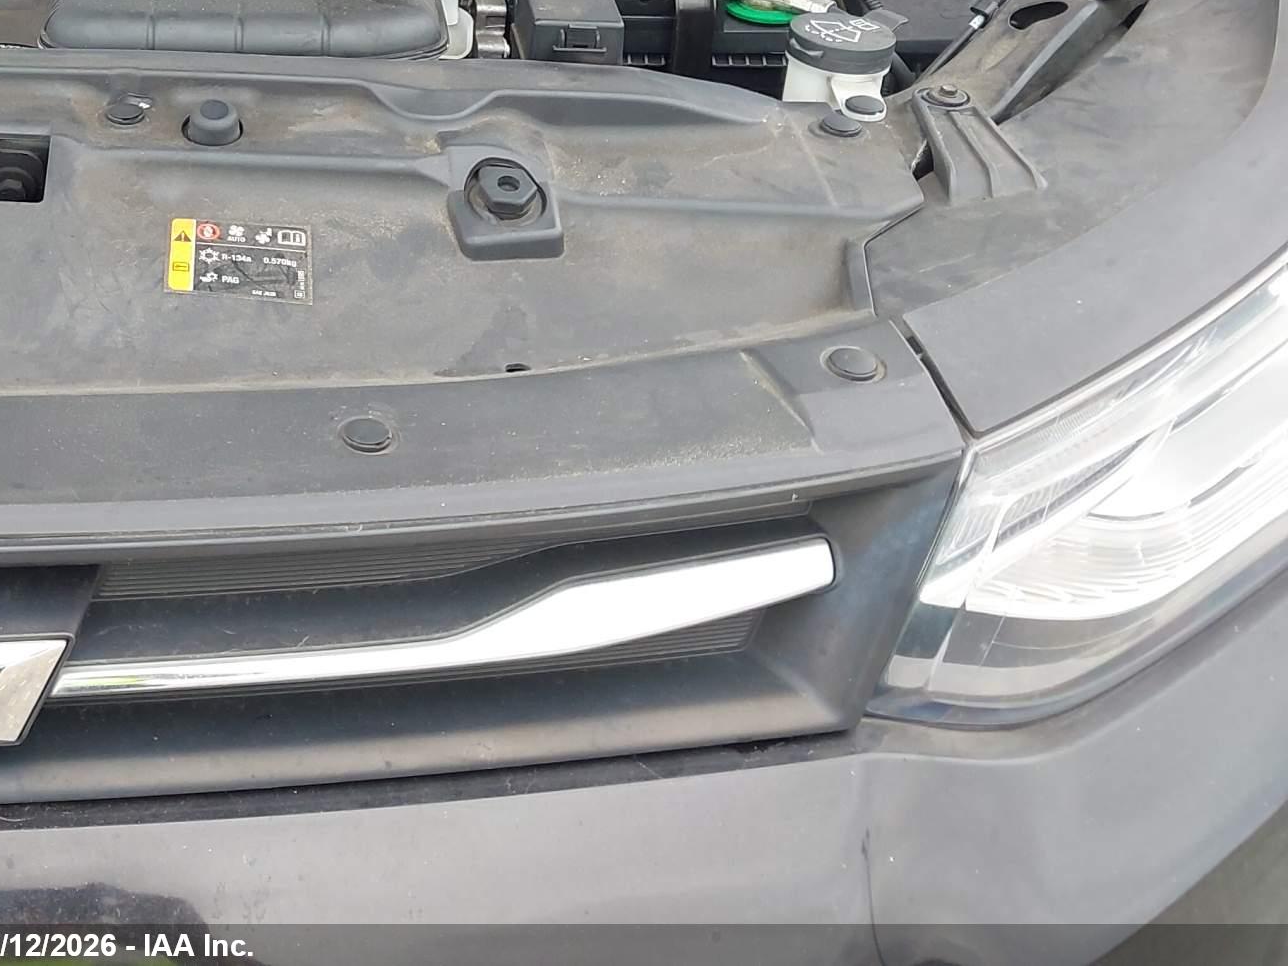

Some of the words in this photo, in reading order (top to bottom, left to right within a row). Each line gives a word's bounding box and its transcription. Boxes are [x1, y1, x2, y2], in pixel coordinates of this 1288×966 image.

[227, 235, 246, 243] AUTO
[221, 253, 252, 263] R-134a
[221, 275, 240, 284] PAG
